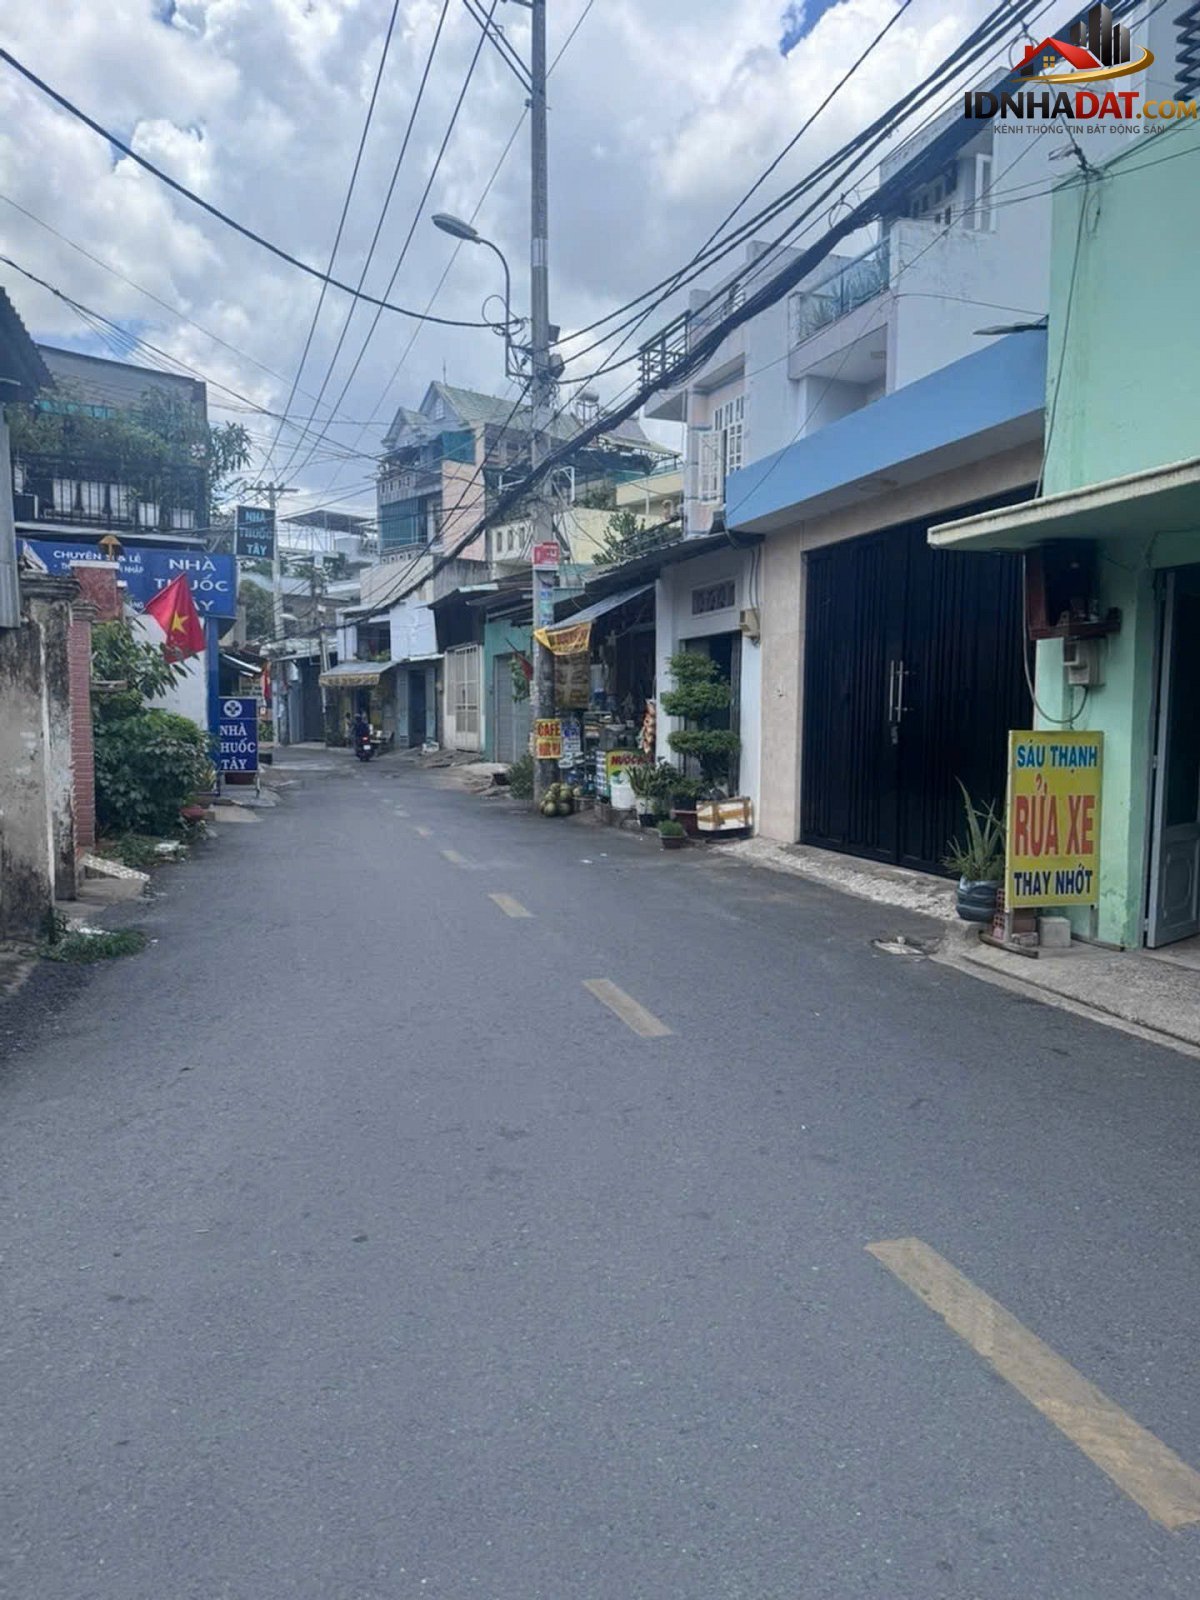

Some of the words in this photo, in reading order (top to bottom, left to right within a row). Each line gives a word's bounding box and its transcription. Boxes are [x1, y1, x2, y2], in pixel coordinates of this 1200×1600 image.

[53, 550, 101, 560] CHUYÊN
[246, 542, 267, 556] TÂY
[169, 555, 217, 572] NHÀ
[219, 722, 247, 736] NHÀ
[220, 737, 256, 753] HUỐC
[221, 756, 247, 770] TÂY
[1017, 740, 1045, 767] SÁU
[1050, 745, 1098, 774] THẠNH
[1014, 773, 1059, 856] RỬA
[1065, 795, 1095, 855] XE
[1014, 871, 1050, 896] THAY
[1055, 863, 1093, 895] NHỚT
